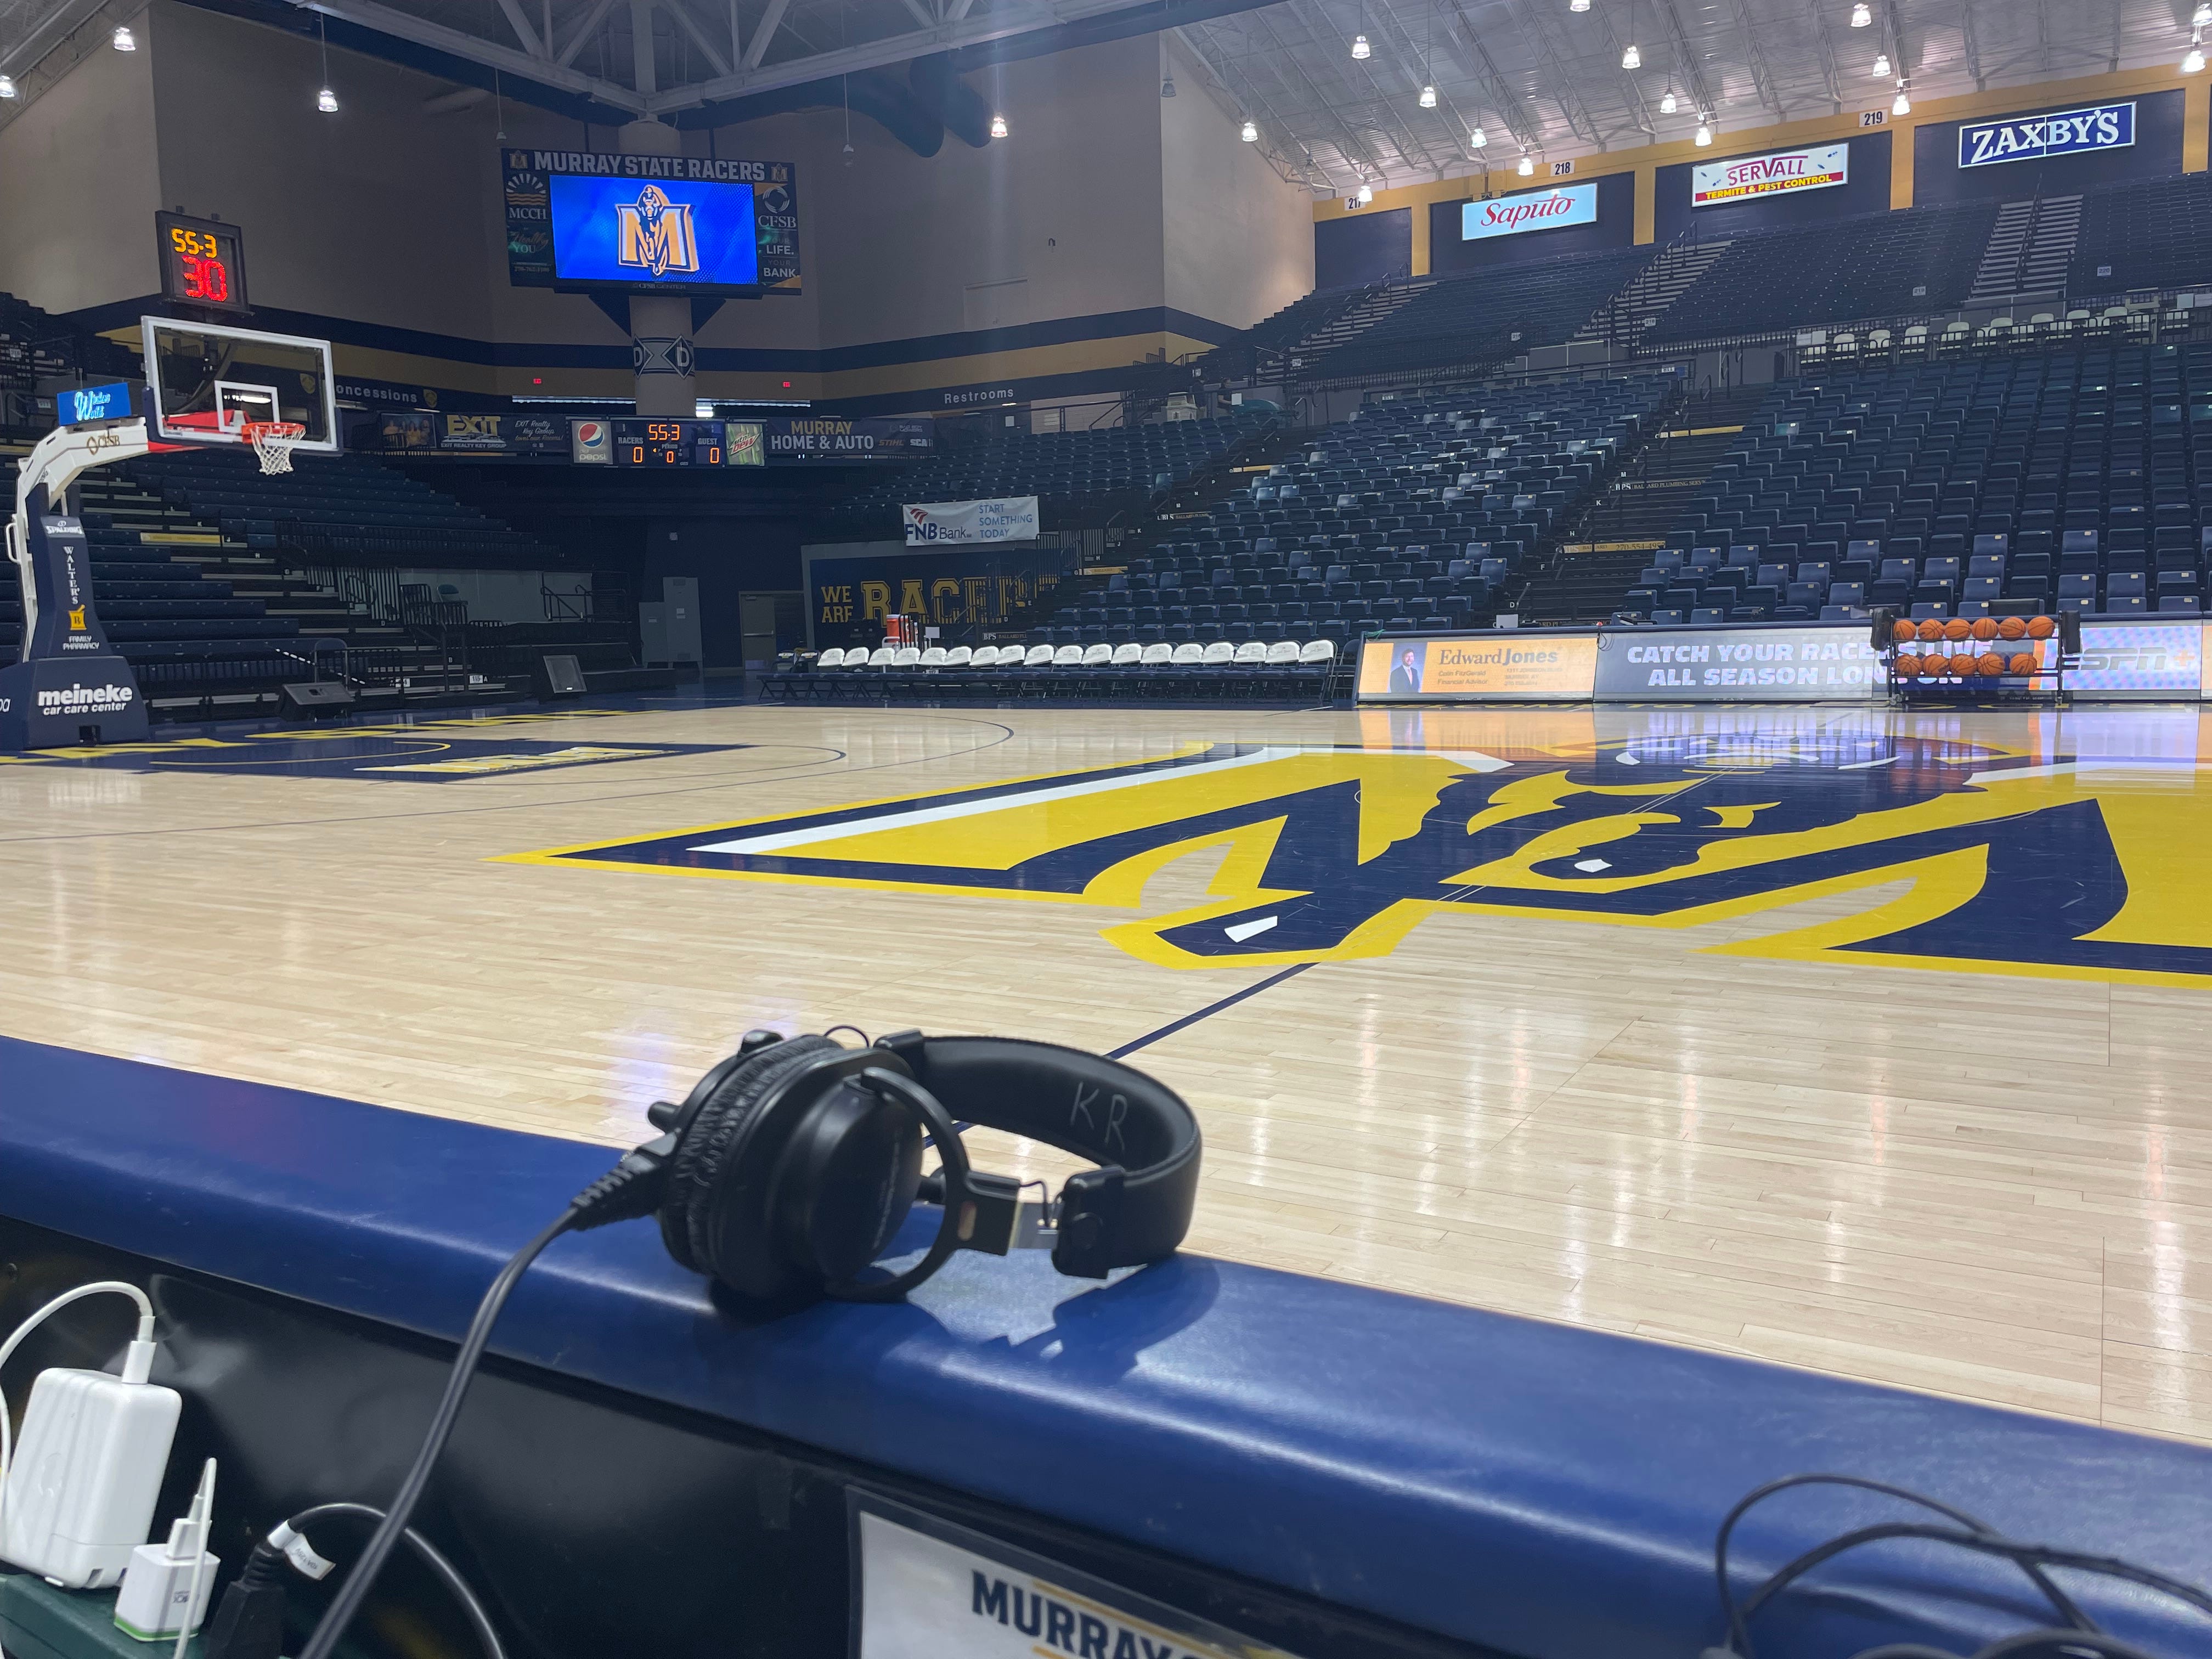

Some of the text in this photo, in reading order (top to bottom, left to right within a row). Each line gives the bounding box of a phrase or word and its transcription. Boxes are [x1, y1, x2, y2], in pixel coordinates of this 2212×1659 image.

[1864, 111, 1882, 125] 219
[1971, 109, 2119, 163] ZAXBY'S
[534, 151, 765, 181] MURRAY STATE RACERS
[1555, 162, 1570, 175] 218
[1726, 155, 1808, 186] SERVALL
[1706, 186, 1746, 200] TERMITE
[1758, 182, 1782, 191] PEST
[1784, 174, 1832, 188] CONTROL
[509, 207, 546, 219] MCCH
[1481, 194, 1576, 229] Saputo
[758, 215, 797, 228] CFSB
[766, 245, 794, 255] LIFE.
[182, 255, 228, 302] 30
[676, 347, 690, 367] D
[335, 384, 417, 403] oncessions
[944, 387, 1014, 404] Restrooms
[447, 414, 501, 436] EXIT
[648, 424, 680, 441] 55.3
[791, 421, 853, 435] MURRAY
[771, 435, 874, 450] HOME & AUTO
[579, 453, 606, 462] pepsi
[633, 446, 643, 464] 0
[667, 450, 674, 463] 0
[710, 447, 720, 464] 0
[979, 504, 1005, 514] START
[979, 514, 1032, 526] SOMETHING
[46, 526, 83, 534] SPALDING
[905, 523, 967, 540] FNB Bank
[979, 528, 1010, 538] TODAY
[821, 585, 851, 603] WE
[1439, 648, 1559, 666] Edward Jones
[1627, 645, 1709, 663] CATCH
[1717, 644, 1794, 662] YOUR
[1801, 641, 1917, 660] RACES
[1647, 668, 1696, 686] ALL
[1703, 667, 1819, 685] SEASON
[1827, 666, 1909, 685] LON
[38, 683, 133, 707] meineke
[43, 702, 127, 715] car care center
[971, 1569, 1173, 1659] MURRAY
